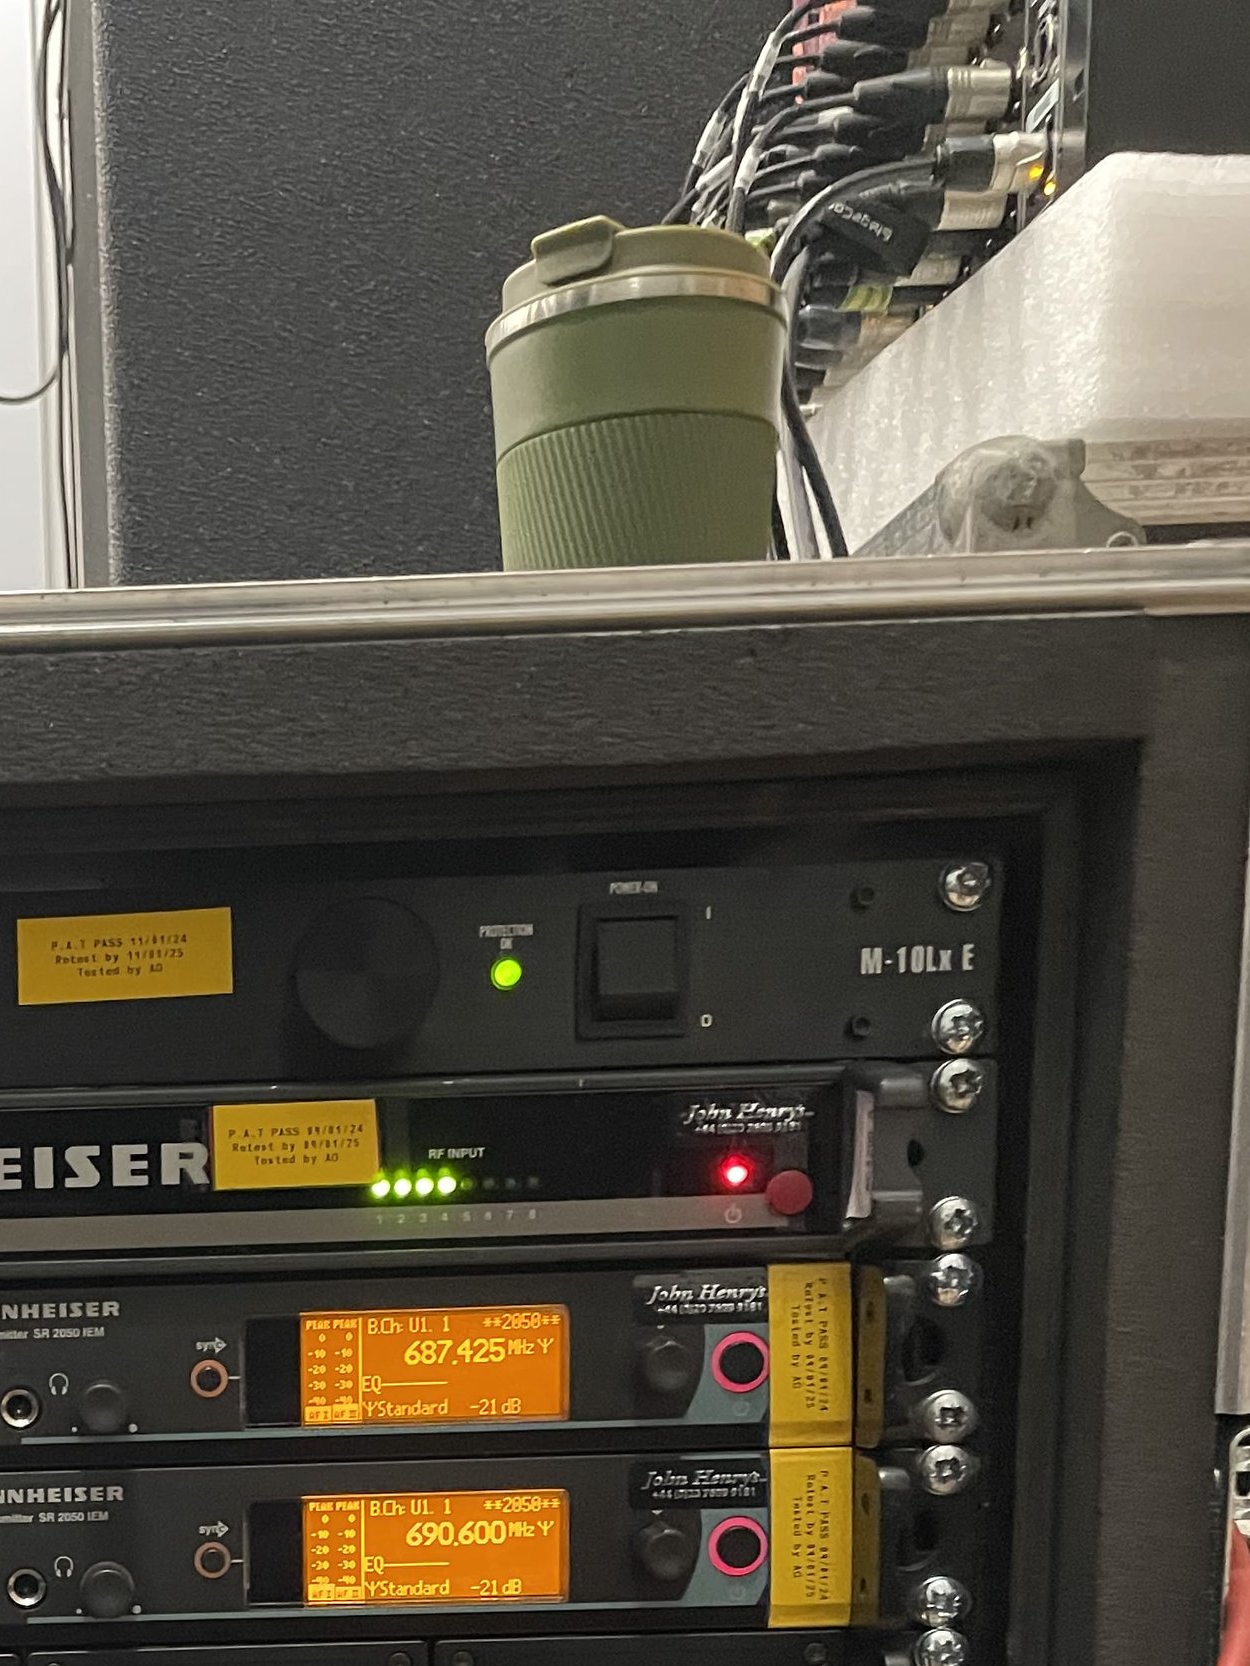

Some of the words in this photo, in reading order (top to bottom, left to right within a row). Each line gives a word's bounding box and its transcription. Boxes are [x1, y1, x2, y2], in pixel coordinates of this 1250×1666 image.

[93, 938, 123, 948] PASS
[130, 934, 187, 946] 11/01/24
[55, 953, 97, 964] Retest
[105, 953, 119, 964] by
[962, 943, 975, 971] E
[78, 966, 120, 977] Tested
[127, 966, 141, 976] by
[682, 1102, 732, 1125] John
[271, 1127, 300, 1137] PASS
[232, 1142, 274, 1153] Retest
[282, 1142, 296, 1152] by
[428, 1148, 445, 1159] RF
[447, 1147, 486, 1159] INPUT
[254, 1155, 296, 1166] Tested
[303, 1155, 317, 1165] by
[376, 1215, 383, 1224] 1
[398, 1214, 406, 1224] 2
[419, 1213, 428, 1223] 3
[441, 1212, 449, 1222] 4
[463, 1211, 471, 1222] 5
[506, 1209, 514, 1220] 7
[645, 1284, 695, 1306] John
[442, 1315, 451, 1333] 1
[33, 1328, 50, 1339] SR
[52, 1327, 81, 1338] 2050
[82, 1327, 105, 1338] IEM
[804, 1331, 814, 1346] by
[818, 1320, 829, 1349] PASS
[404, 1337, 506, 1366] 687.425
[507, 1338, 535, 1355] MHz
[791, 1354, 801, 1368] by
[362, 1375, 383, 1394] EQ
[378, 1399, 449, 1417] Standard
[469, 1399, 498, 1416] -21
[502, 1398, 522, 1415] dB
[640, 1469, 689, 1490] John
[443, 1498, 452, 1515] 1
[38, 1512, 55, 1523] SR
[57, 1511, 85, 1522] 2050
[87, 1511, 109, 1521] IEM
[405, 1520, 506, 1547] 690.600
[508, 1521, 535, 1538] MHz
[364, 1556, 385, 1575] EQ
[380, 1579, 450, 1596] Standard
[470, 1579, 498, 1596] -21
[502, 1578, 522, 1595] dB
